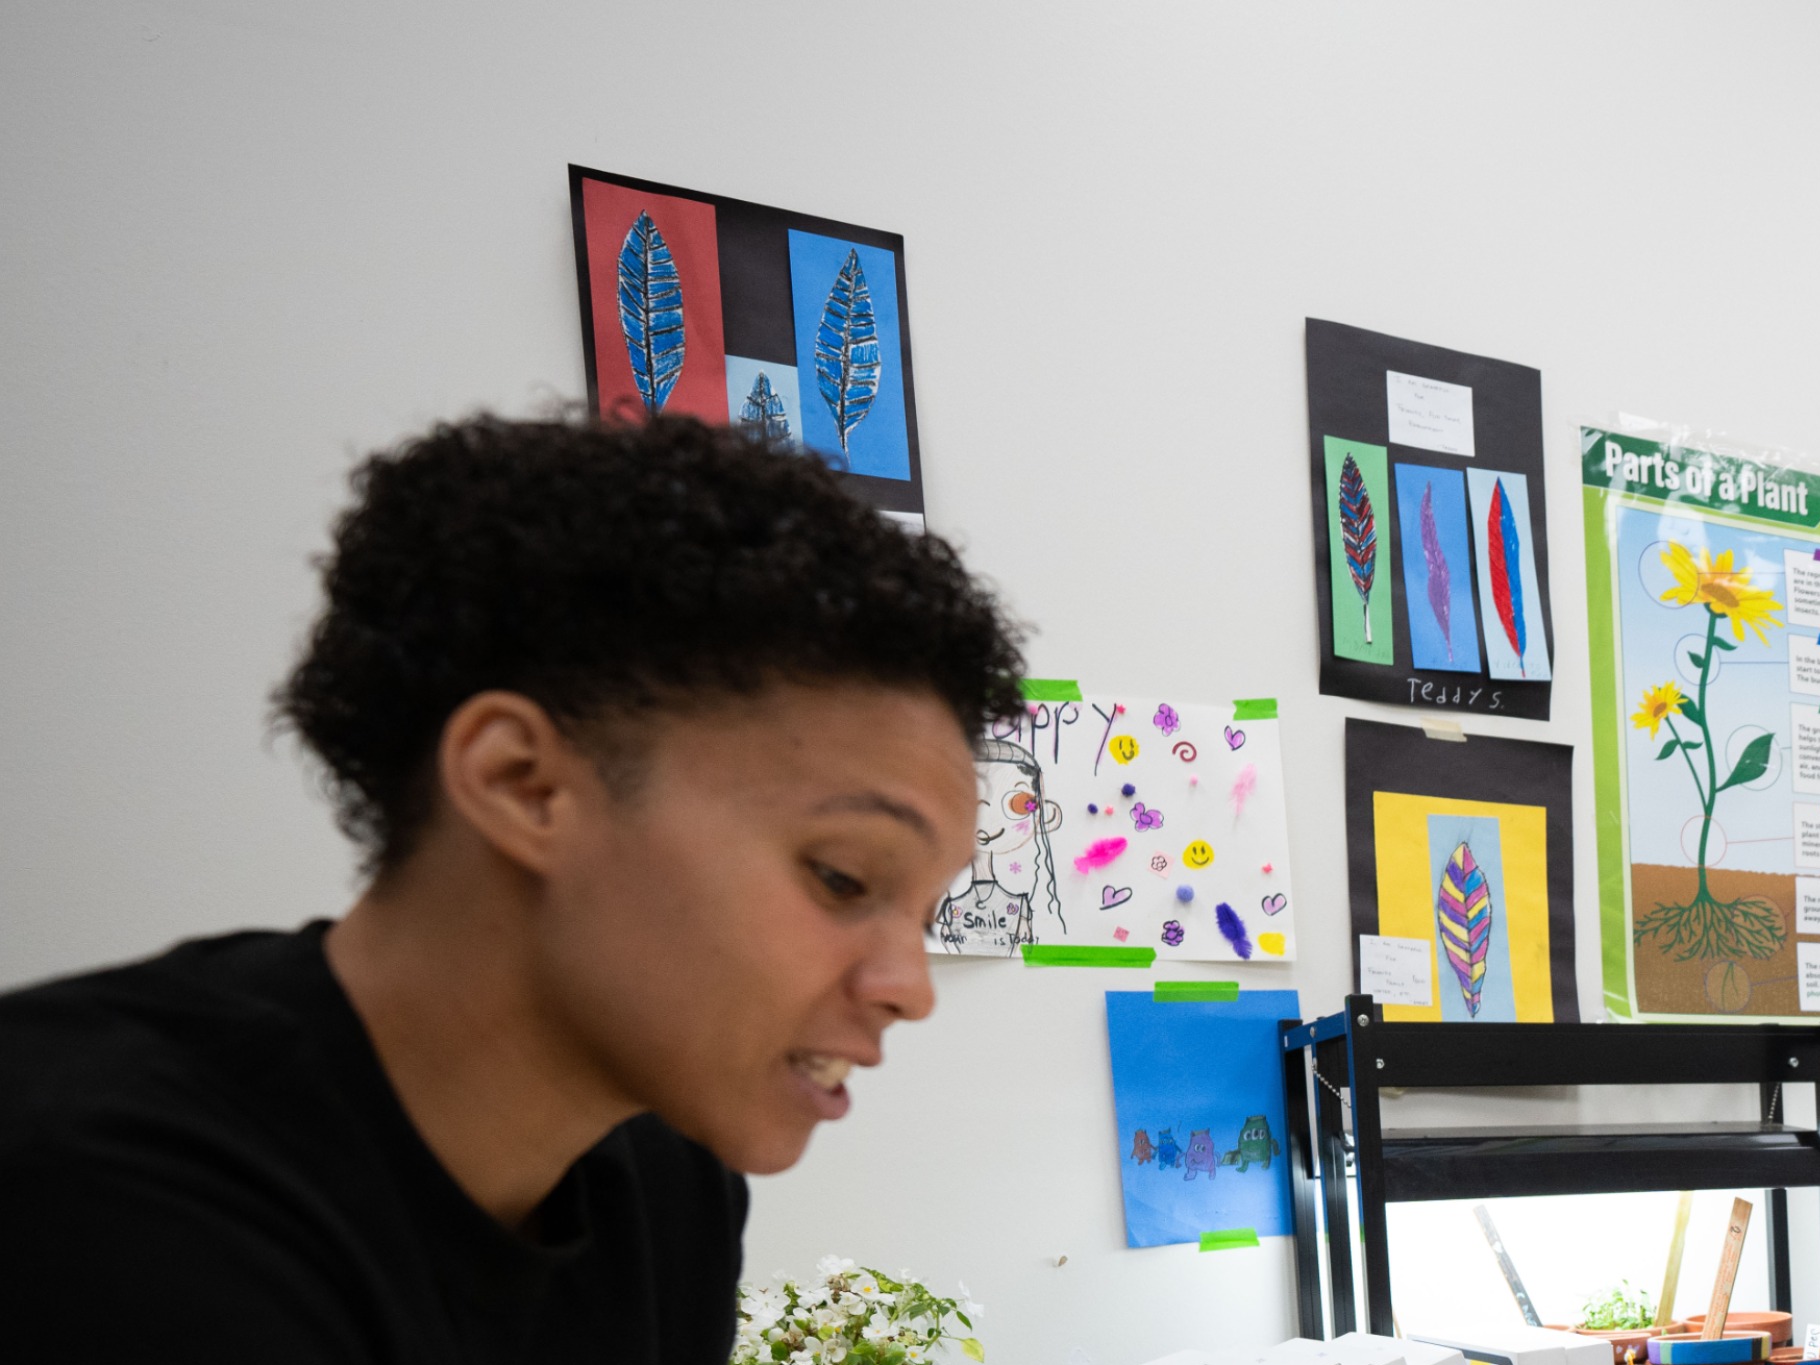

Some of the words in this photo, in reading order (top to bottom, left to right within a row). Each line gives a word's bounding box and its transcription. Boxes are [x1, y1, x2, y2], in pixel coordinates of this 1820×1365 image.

[1604, 440, 1681, 490] Parts
[1685, 460, 1713, 497] of
[1718, 472, 1735, 501] a
[1741, 468, 1808, 516] Plant
[1407, 677, 1482, 705] Teddy
[992, 701, 1117, 777] appy
[963, 910, 1007, 929] Smile
